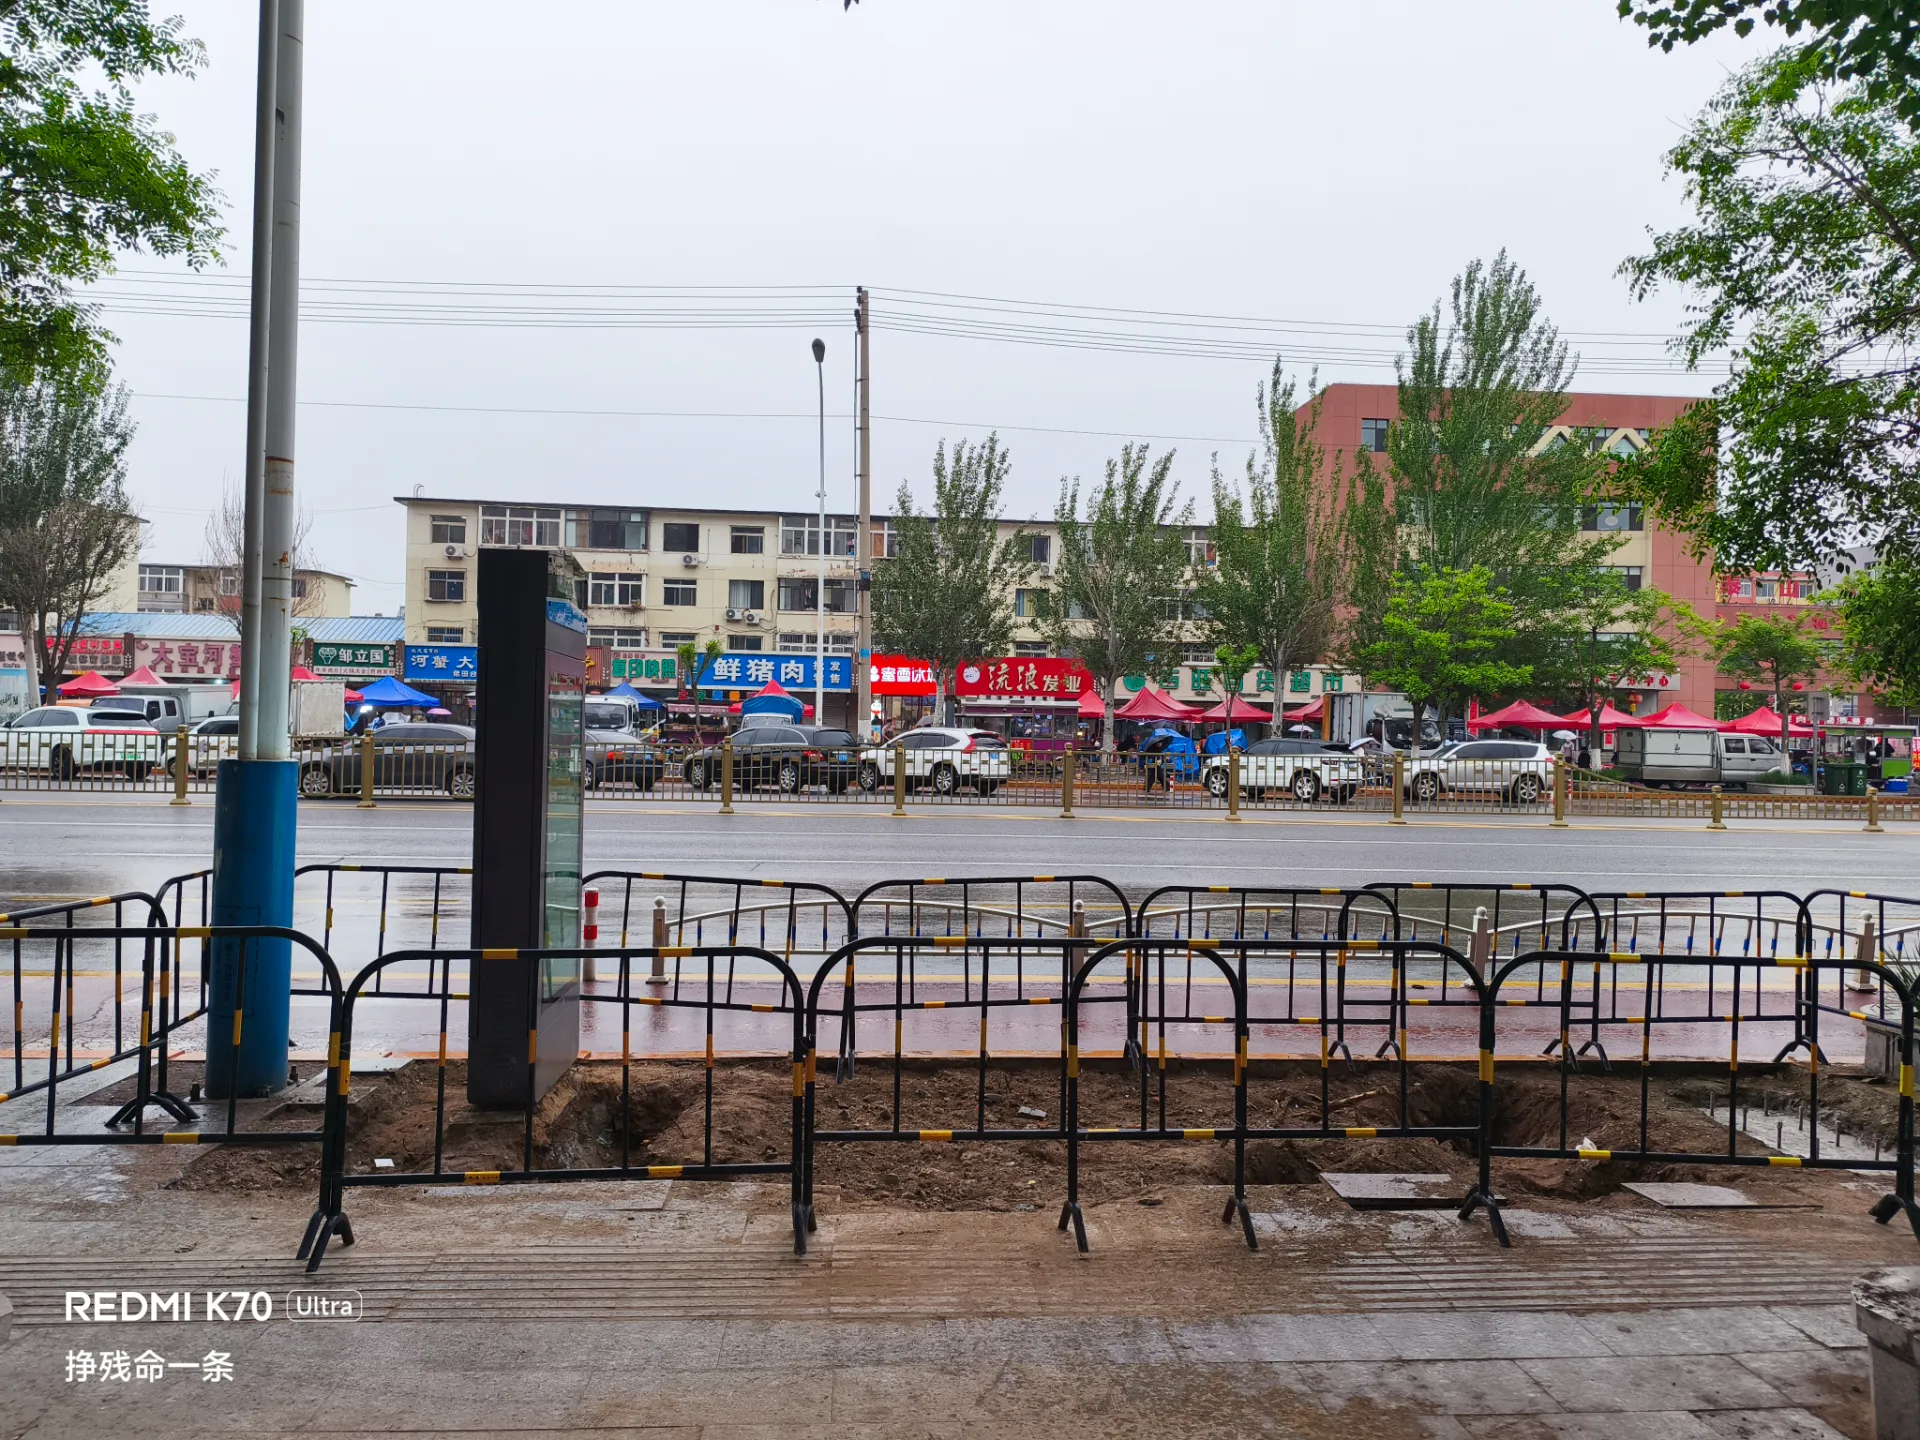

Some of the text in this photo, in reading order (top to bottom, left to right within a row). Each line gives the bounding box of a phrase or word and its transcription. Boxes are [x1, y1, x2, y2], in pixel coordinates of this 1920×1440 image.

[338, 647, 384, 664] 邹立国
[612, 658, 677, 679] 复印快照
[713, 658, 804, 683] 鲜猪肉
[988, 663, 1081, 692] 流浪发业
